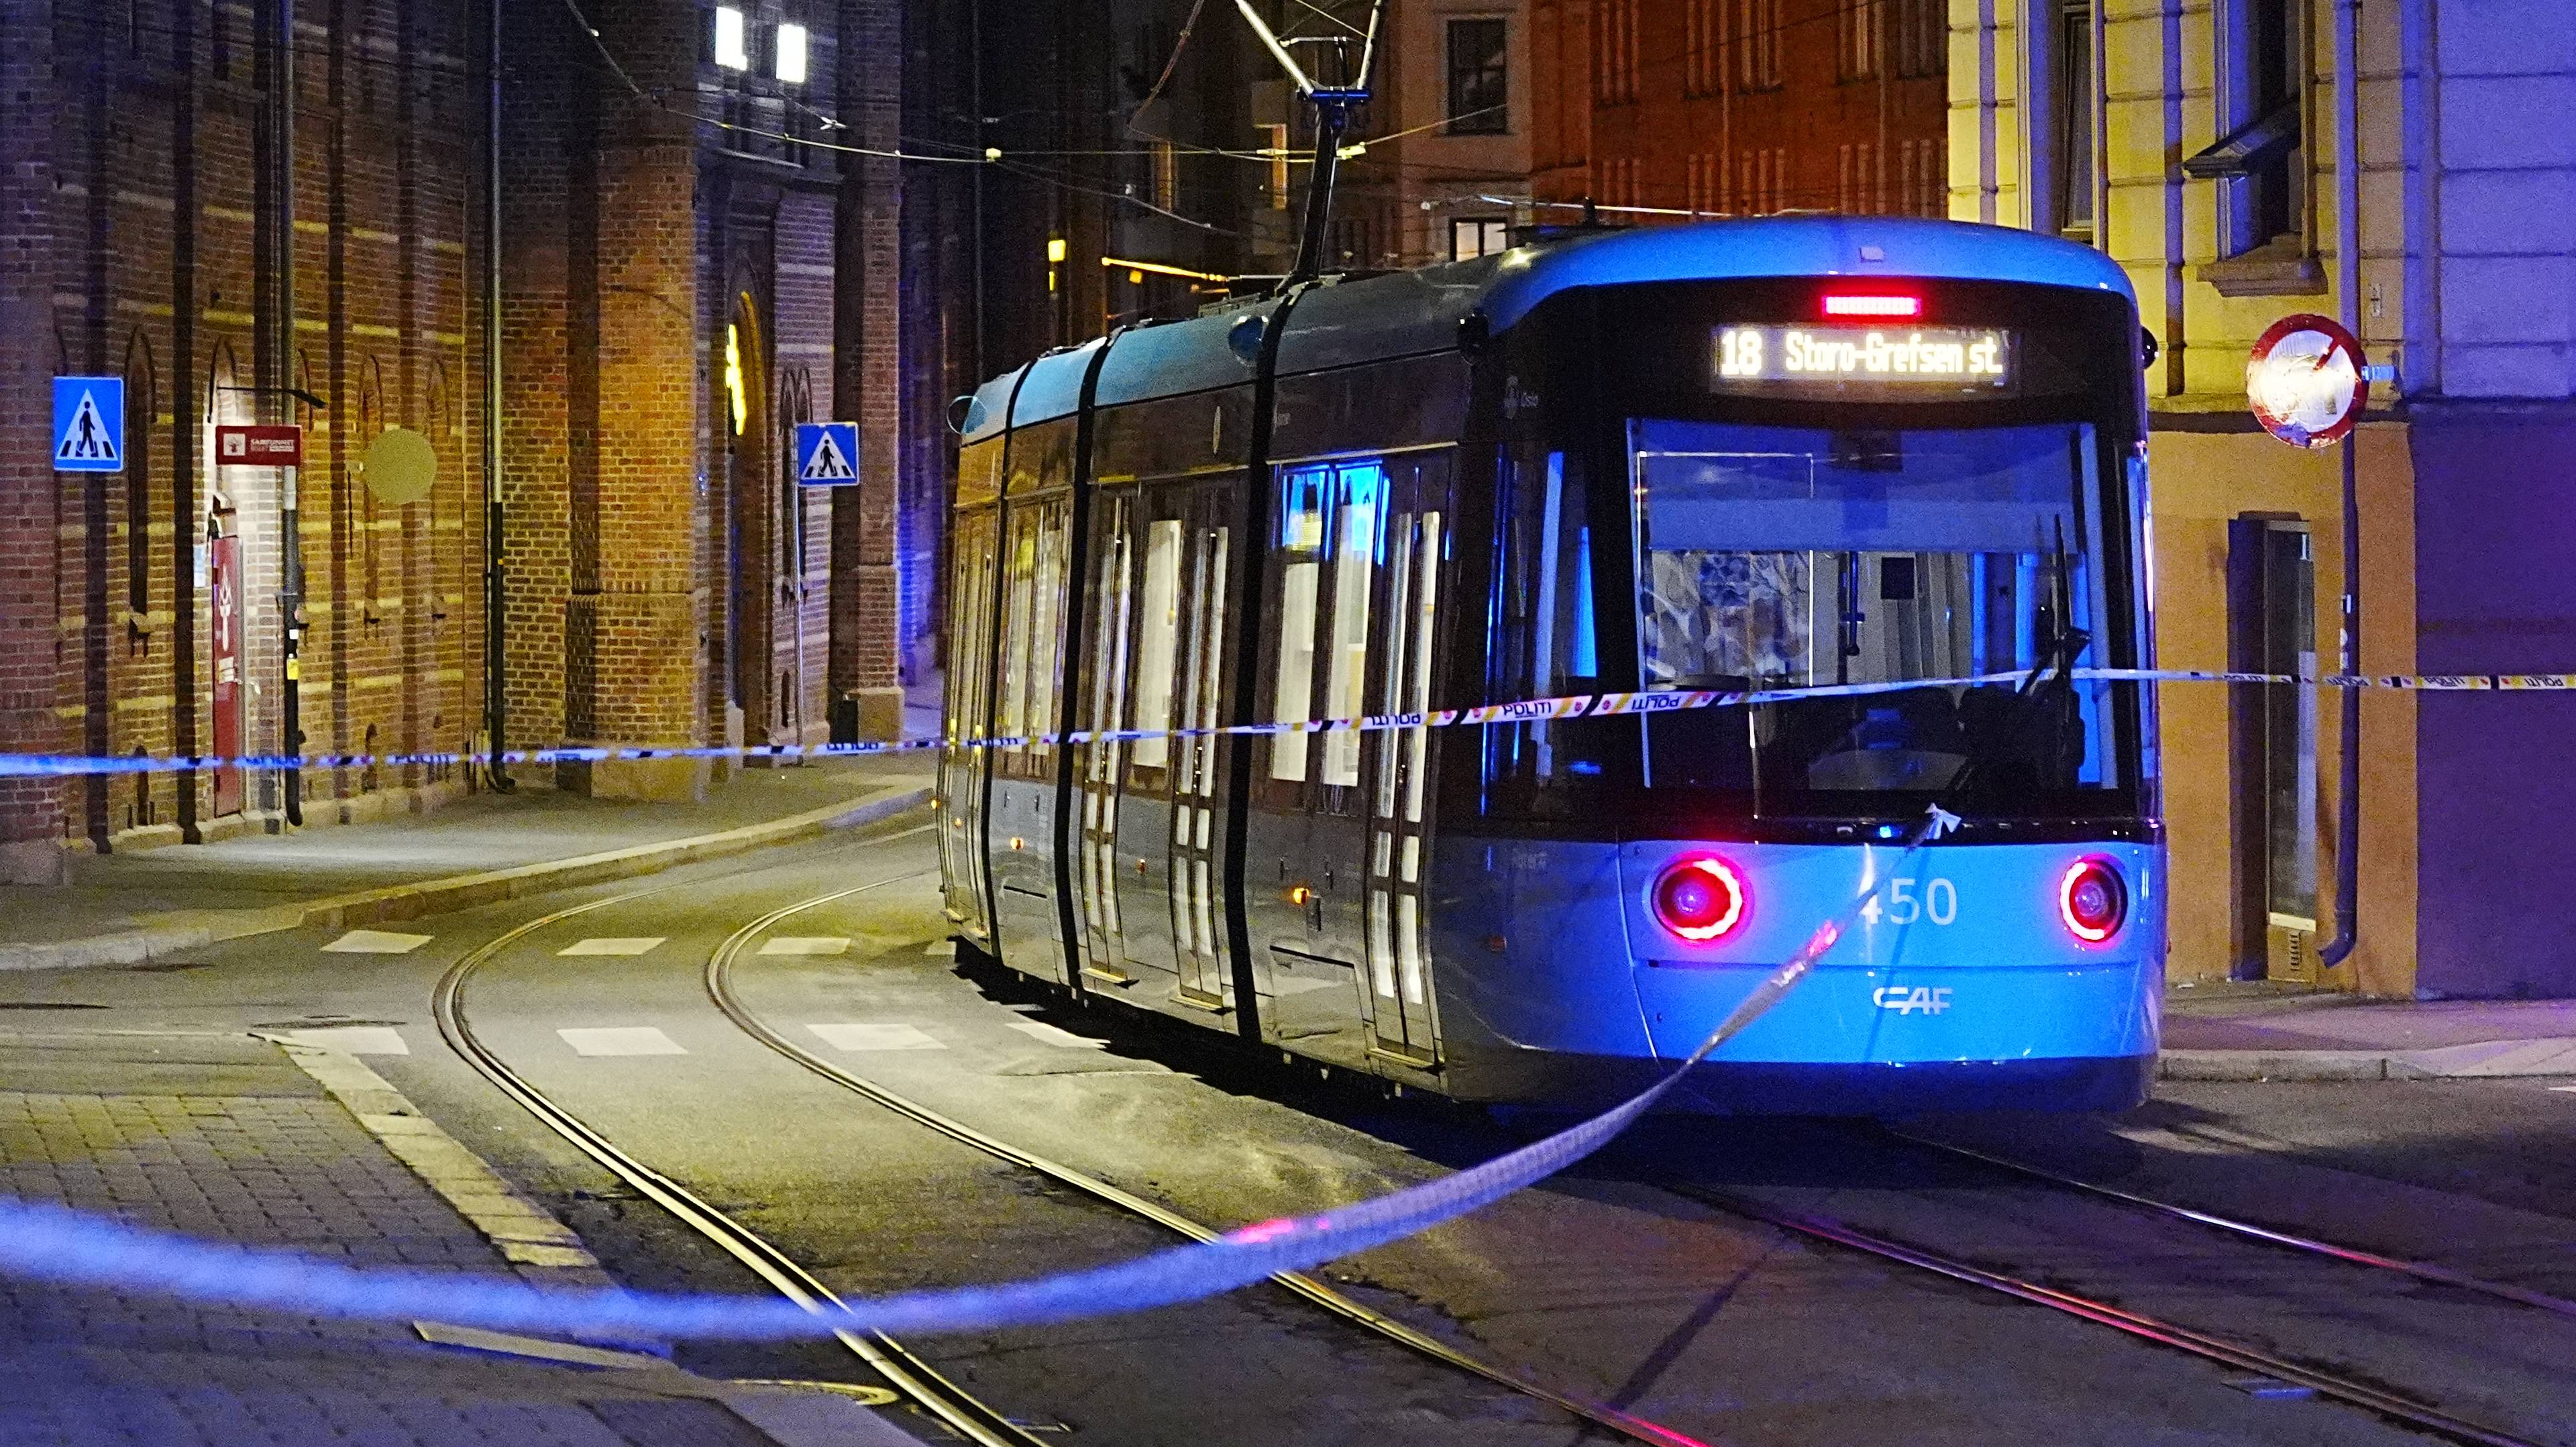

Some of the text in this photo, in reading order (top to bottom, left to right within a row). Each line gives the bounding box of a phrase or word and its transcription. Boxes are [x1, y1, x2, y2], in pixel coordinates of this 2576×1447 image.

[1721, 331, 2003, 375] 18 Storo-Grefsen st.
[2423, 676, 2467, 686] POLITI
[2524, 677, 2565, 687] POLITI
[1502, 702, 1552, 716] POLITI
[1631, 694, 1679, 711] POLITI
[1371, 712, 1421, 726] POLITI
[1860, 877, 1957, 925] 450
[1873, 987, 1953, 1015] CAF
